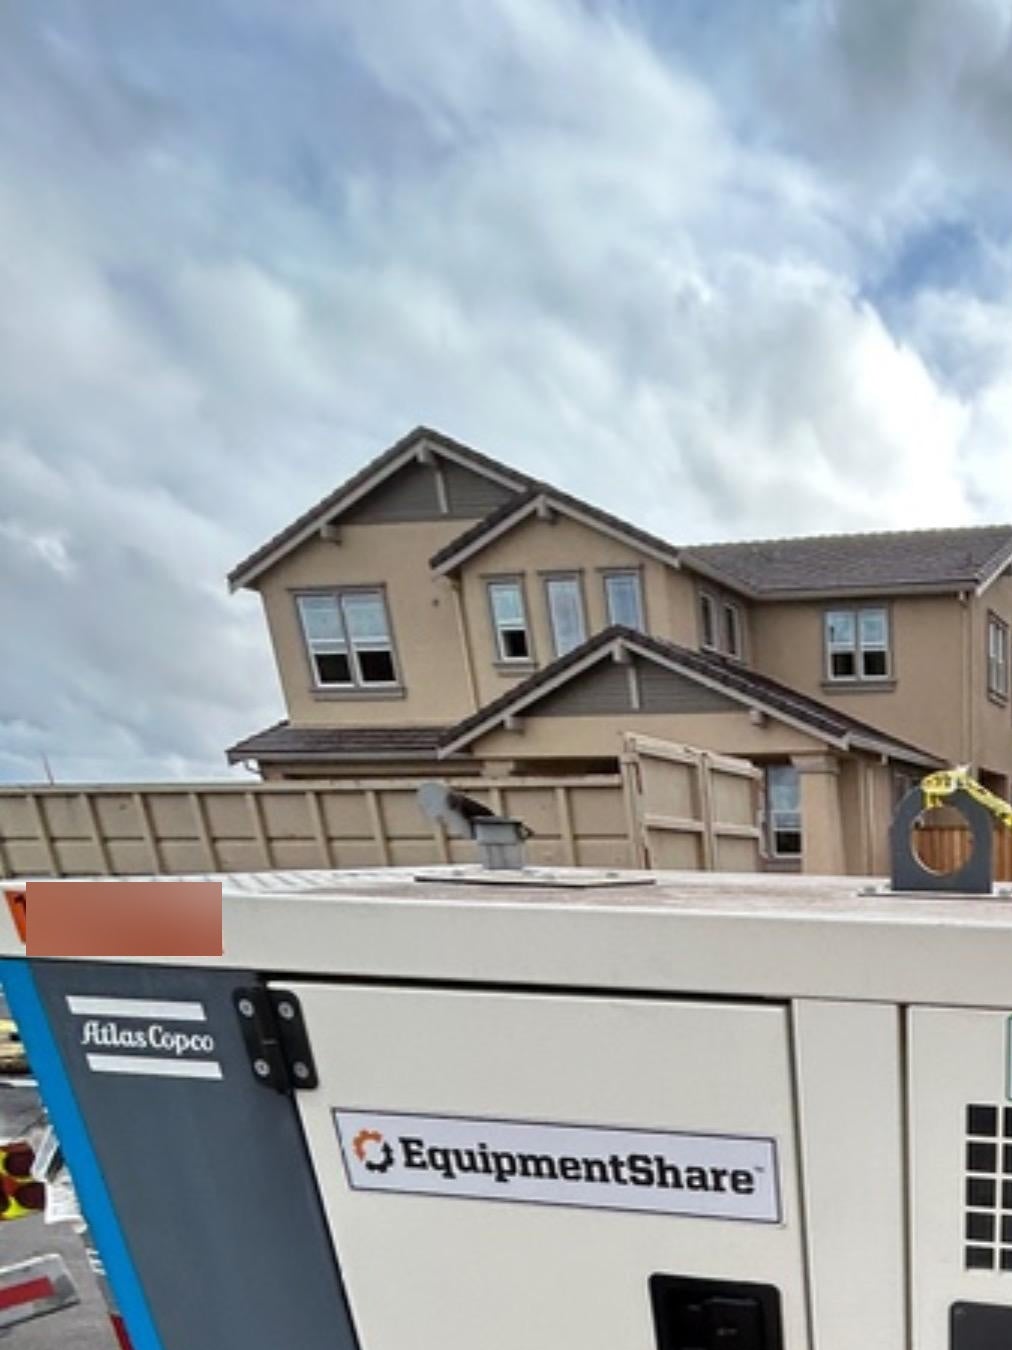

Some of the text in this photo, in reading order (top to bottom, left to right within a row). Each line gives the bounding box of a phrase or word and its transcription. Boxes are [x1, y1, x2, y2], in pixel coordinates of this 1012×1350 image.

[80, 1020, 214, 1056] Atlas Copco
[398, 1135, 755, 1195] EquipmentShare
